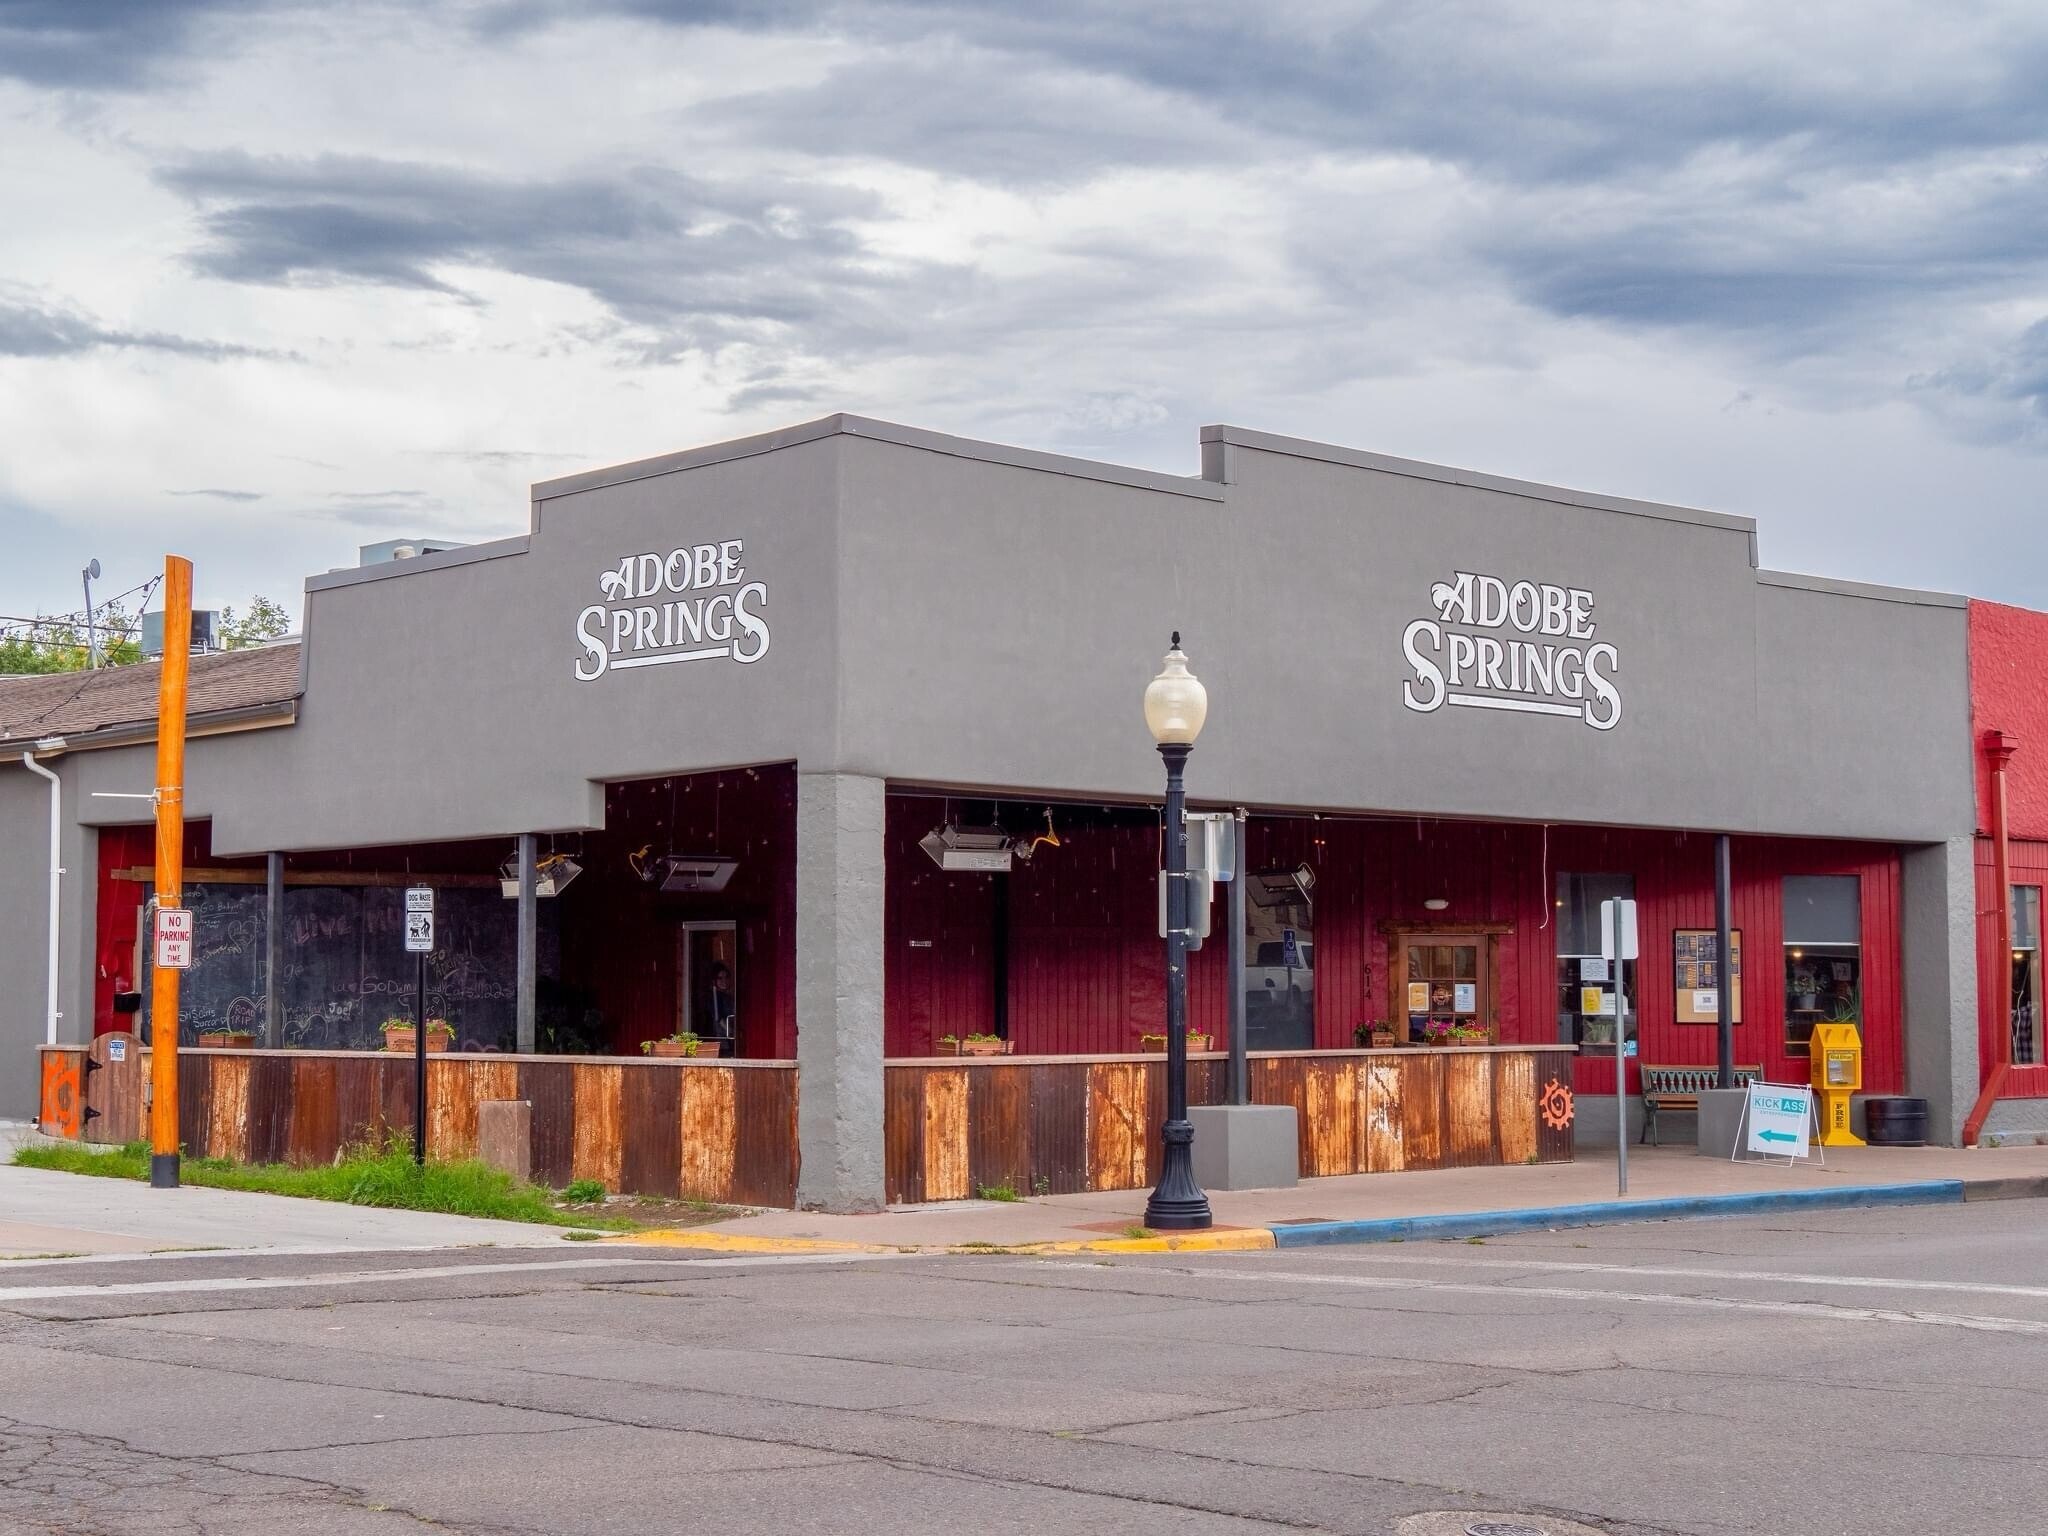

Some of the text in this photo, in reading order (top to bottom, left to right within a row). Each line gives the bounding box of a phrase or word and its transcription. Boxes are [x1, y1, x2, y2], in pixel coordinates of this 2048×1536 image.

[600, 539, 745, 602] ADOBE
[1431, 570, 1597, 640] ADOBE
[574, 581, 770, 682] SPRINGS
[1402, 618, 1622, 731] SPRINGS
[168, 916, 182, 927] NO
[160, 930, 190, 942] PARKING
[167, 944, 181, 952] ANY
[167, 954, 182, 962] TIME
[1754, 1096, 1806, 1112] KICK ASS
[1835, 1103, 1845, 1129] FREE
